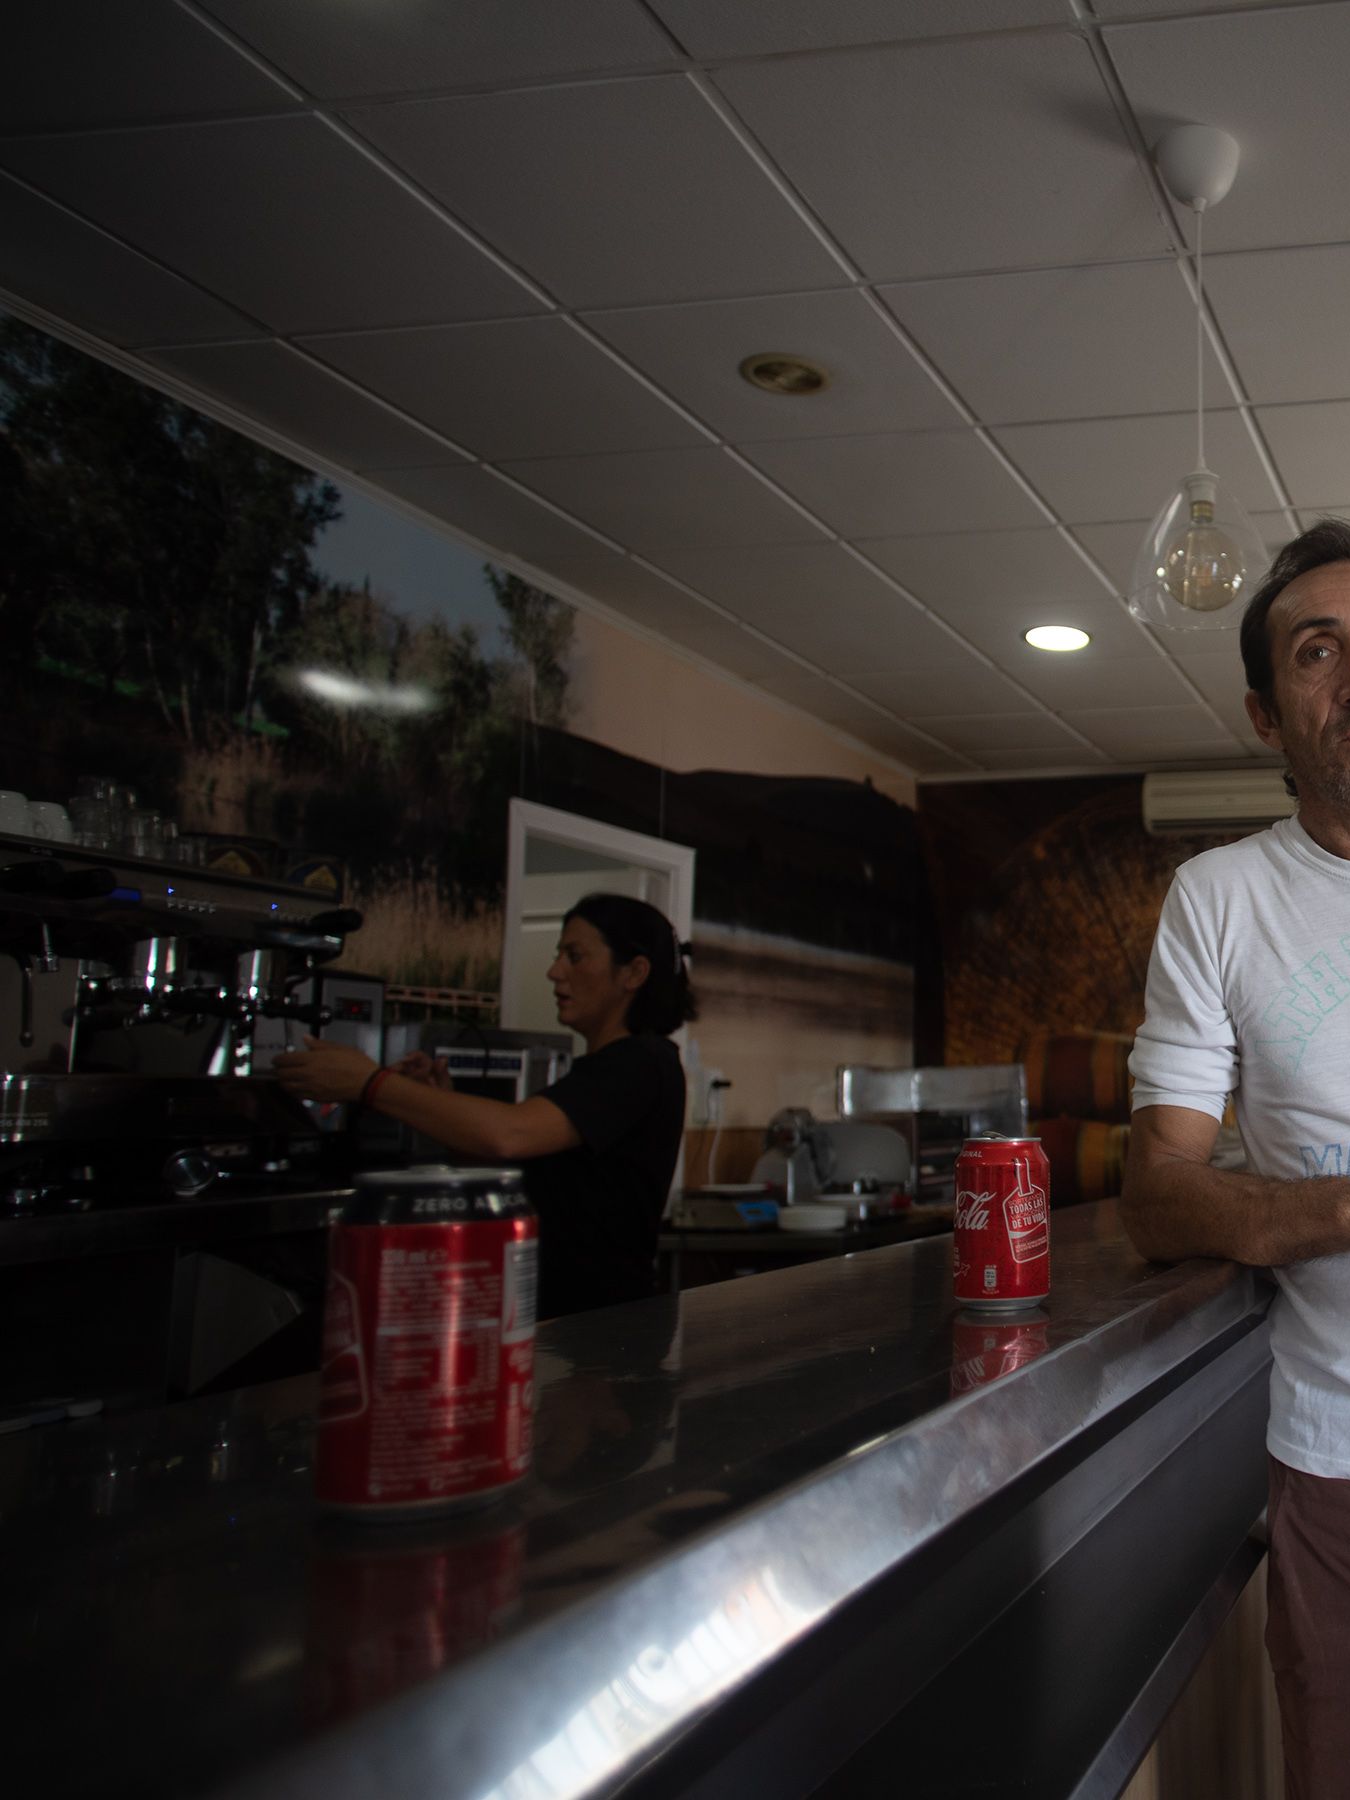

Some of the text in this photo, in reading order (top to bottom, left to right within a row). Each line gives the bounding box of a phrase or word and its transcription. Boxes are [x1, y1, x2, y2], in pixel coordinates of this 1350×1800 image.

[411, 1196, 469, 1213] ZERO
[1009, 1197, 1044, 1215] TODAS LAS
[1011, 1218, 1023, 1230] DE
[1023, 1216, 1032, 1227] TU
